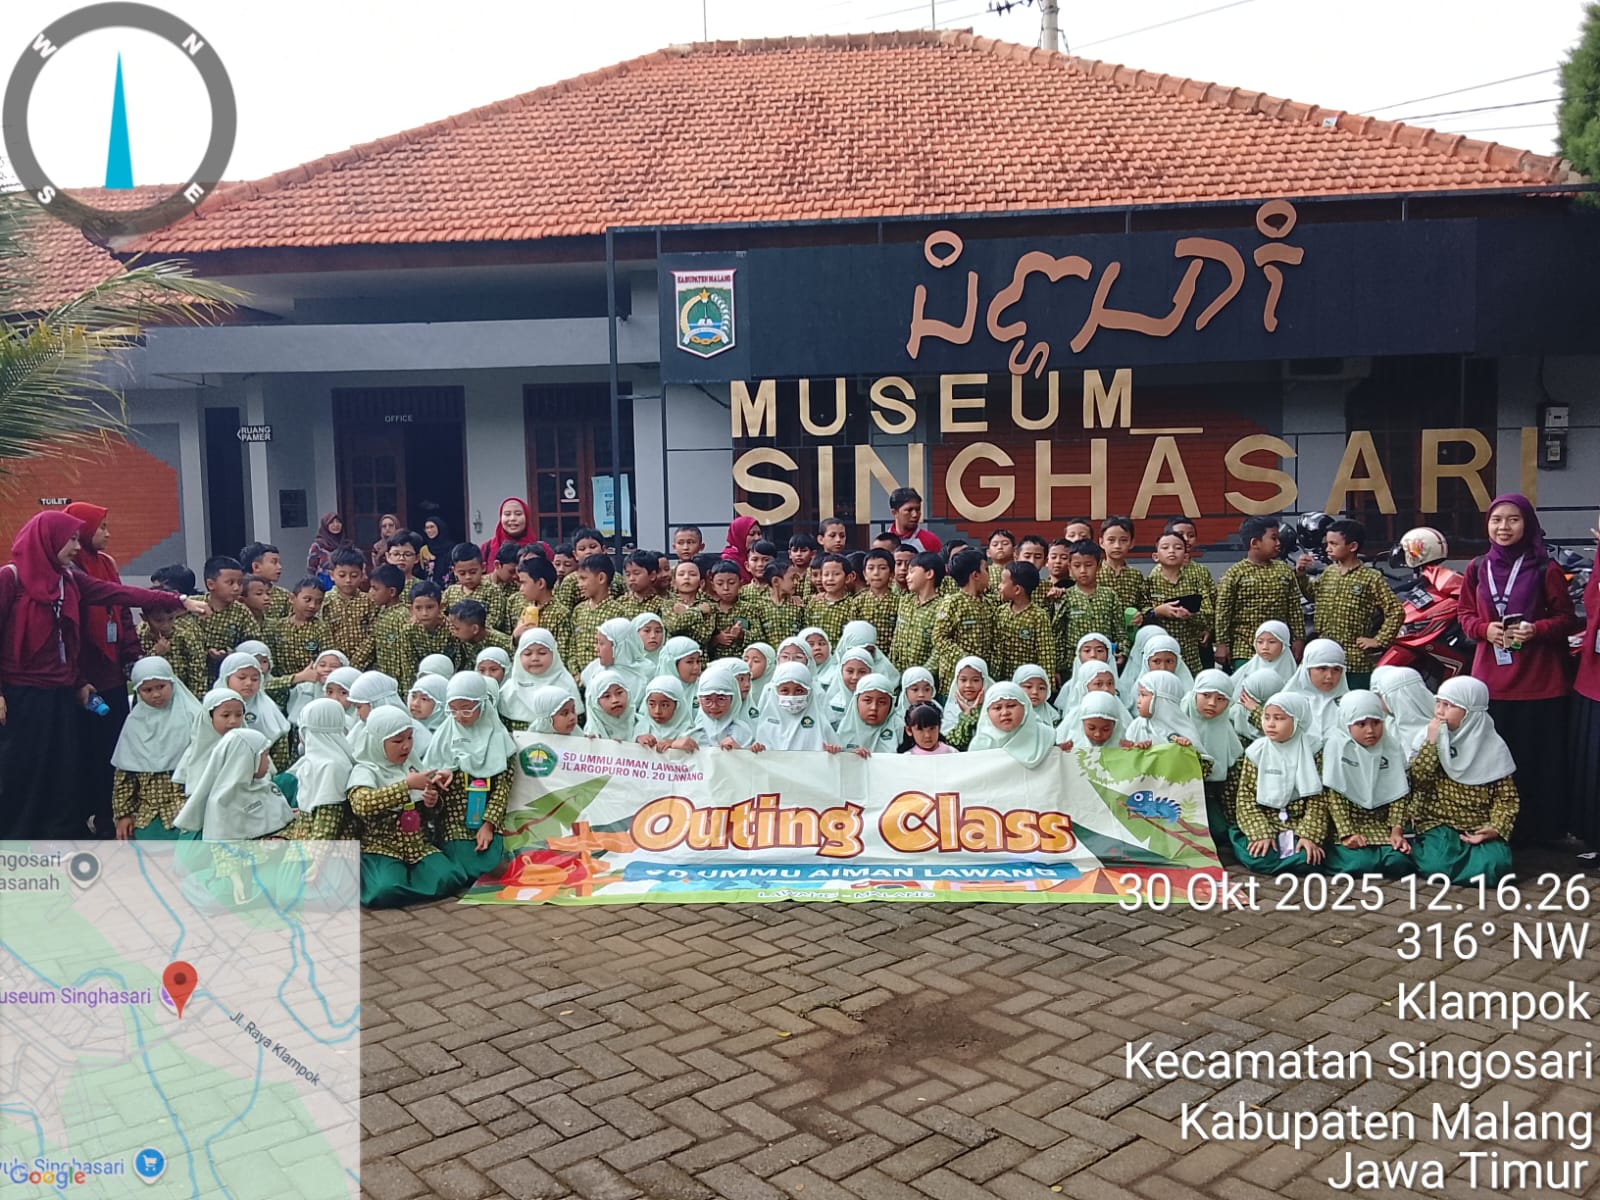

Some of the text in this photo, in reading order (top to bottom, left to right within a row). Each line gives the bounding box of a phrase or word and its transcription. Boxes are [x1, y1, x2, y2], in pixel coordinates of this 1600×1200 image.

[730, 368, 1132, 438] MUSEUM
[241, 433, 271, 441] PAMER
[41, 497, 67, 505] TOILET
[562, 752, 689, 773] SD UMMU AIMAN LAWANG
[632, 769, 650, 780] NO.
[652, 771, 666, 781] 20
[667, 771, 704, 783] LAWANG
[629, 789, 1077, 858] Outing Class
[699, 866, 801, 879] UMMU
[808, 862, 924, 880] AIMAN
[931, 861, 1058, 878] LAWANG
